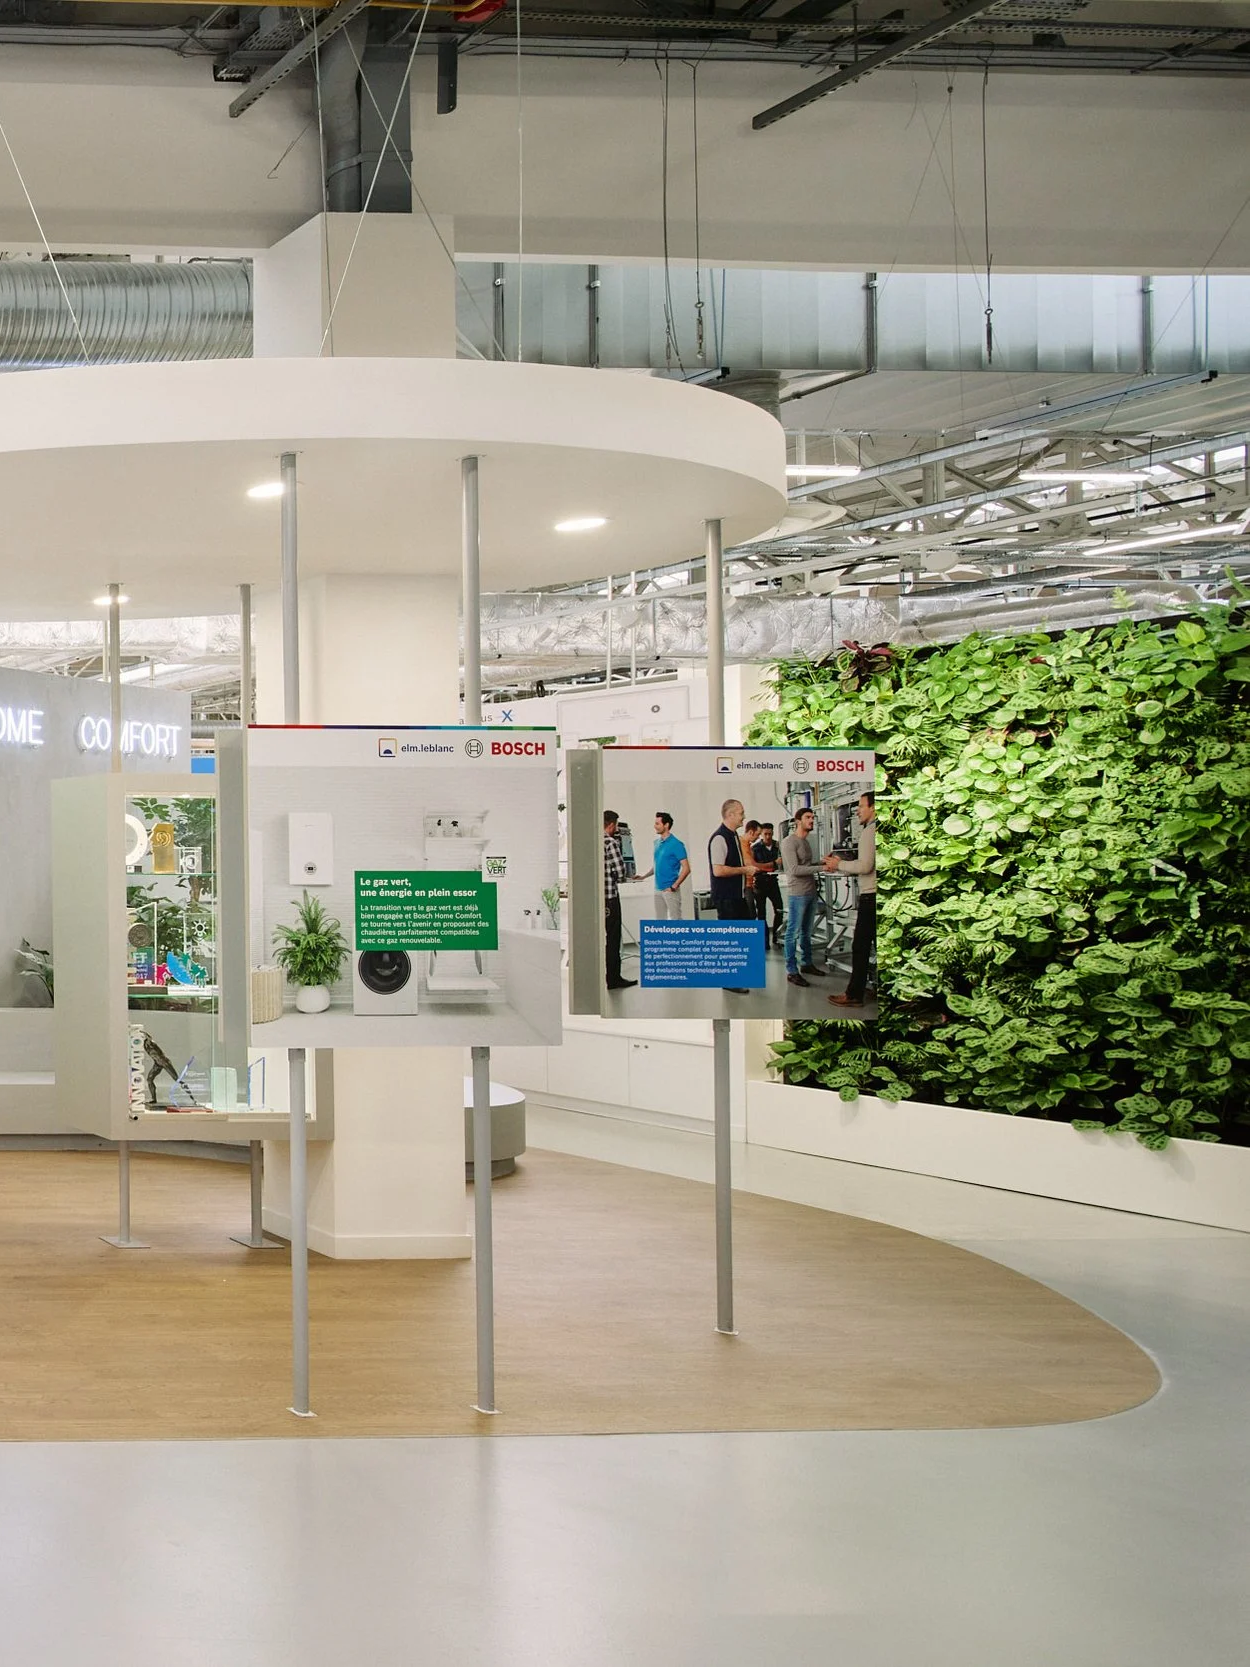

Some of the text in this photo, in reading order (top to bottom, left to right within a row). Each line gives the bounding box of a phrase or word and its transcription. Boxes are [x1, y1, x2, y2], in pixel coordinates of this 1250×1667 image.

[401, 742, 546, 756] elm.leblanc BOSCH
[736, 760, 864, 772] elm.leblanc BOSCH
[487, 866, 506, 874] VERT
[360, 877, 412, 888] Le gaz vert,
[379, 888, 412, 899] énergie
[428, 888, 450, 899] plein
[464, 904, 478, 912] déjà
[376, 912, 403, 921] engagée
[443, 921, 476, 929] proposant
[360, 928, 480, 937] chaudières parfaitement compatibles
[644, 926, 689, 934] Développez
[706, 926, 758, 934] compétences
[131, 1024, 145, 1112] INNOVATION
